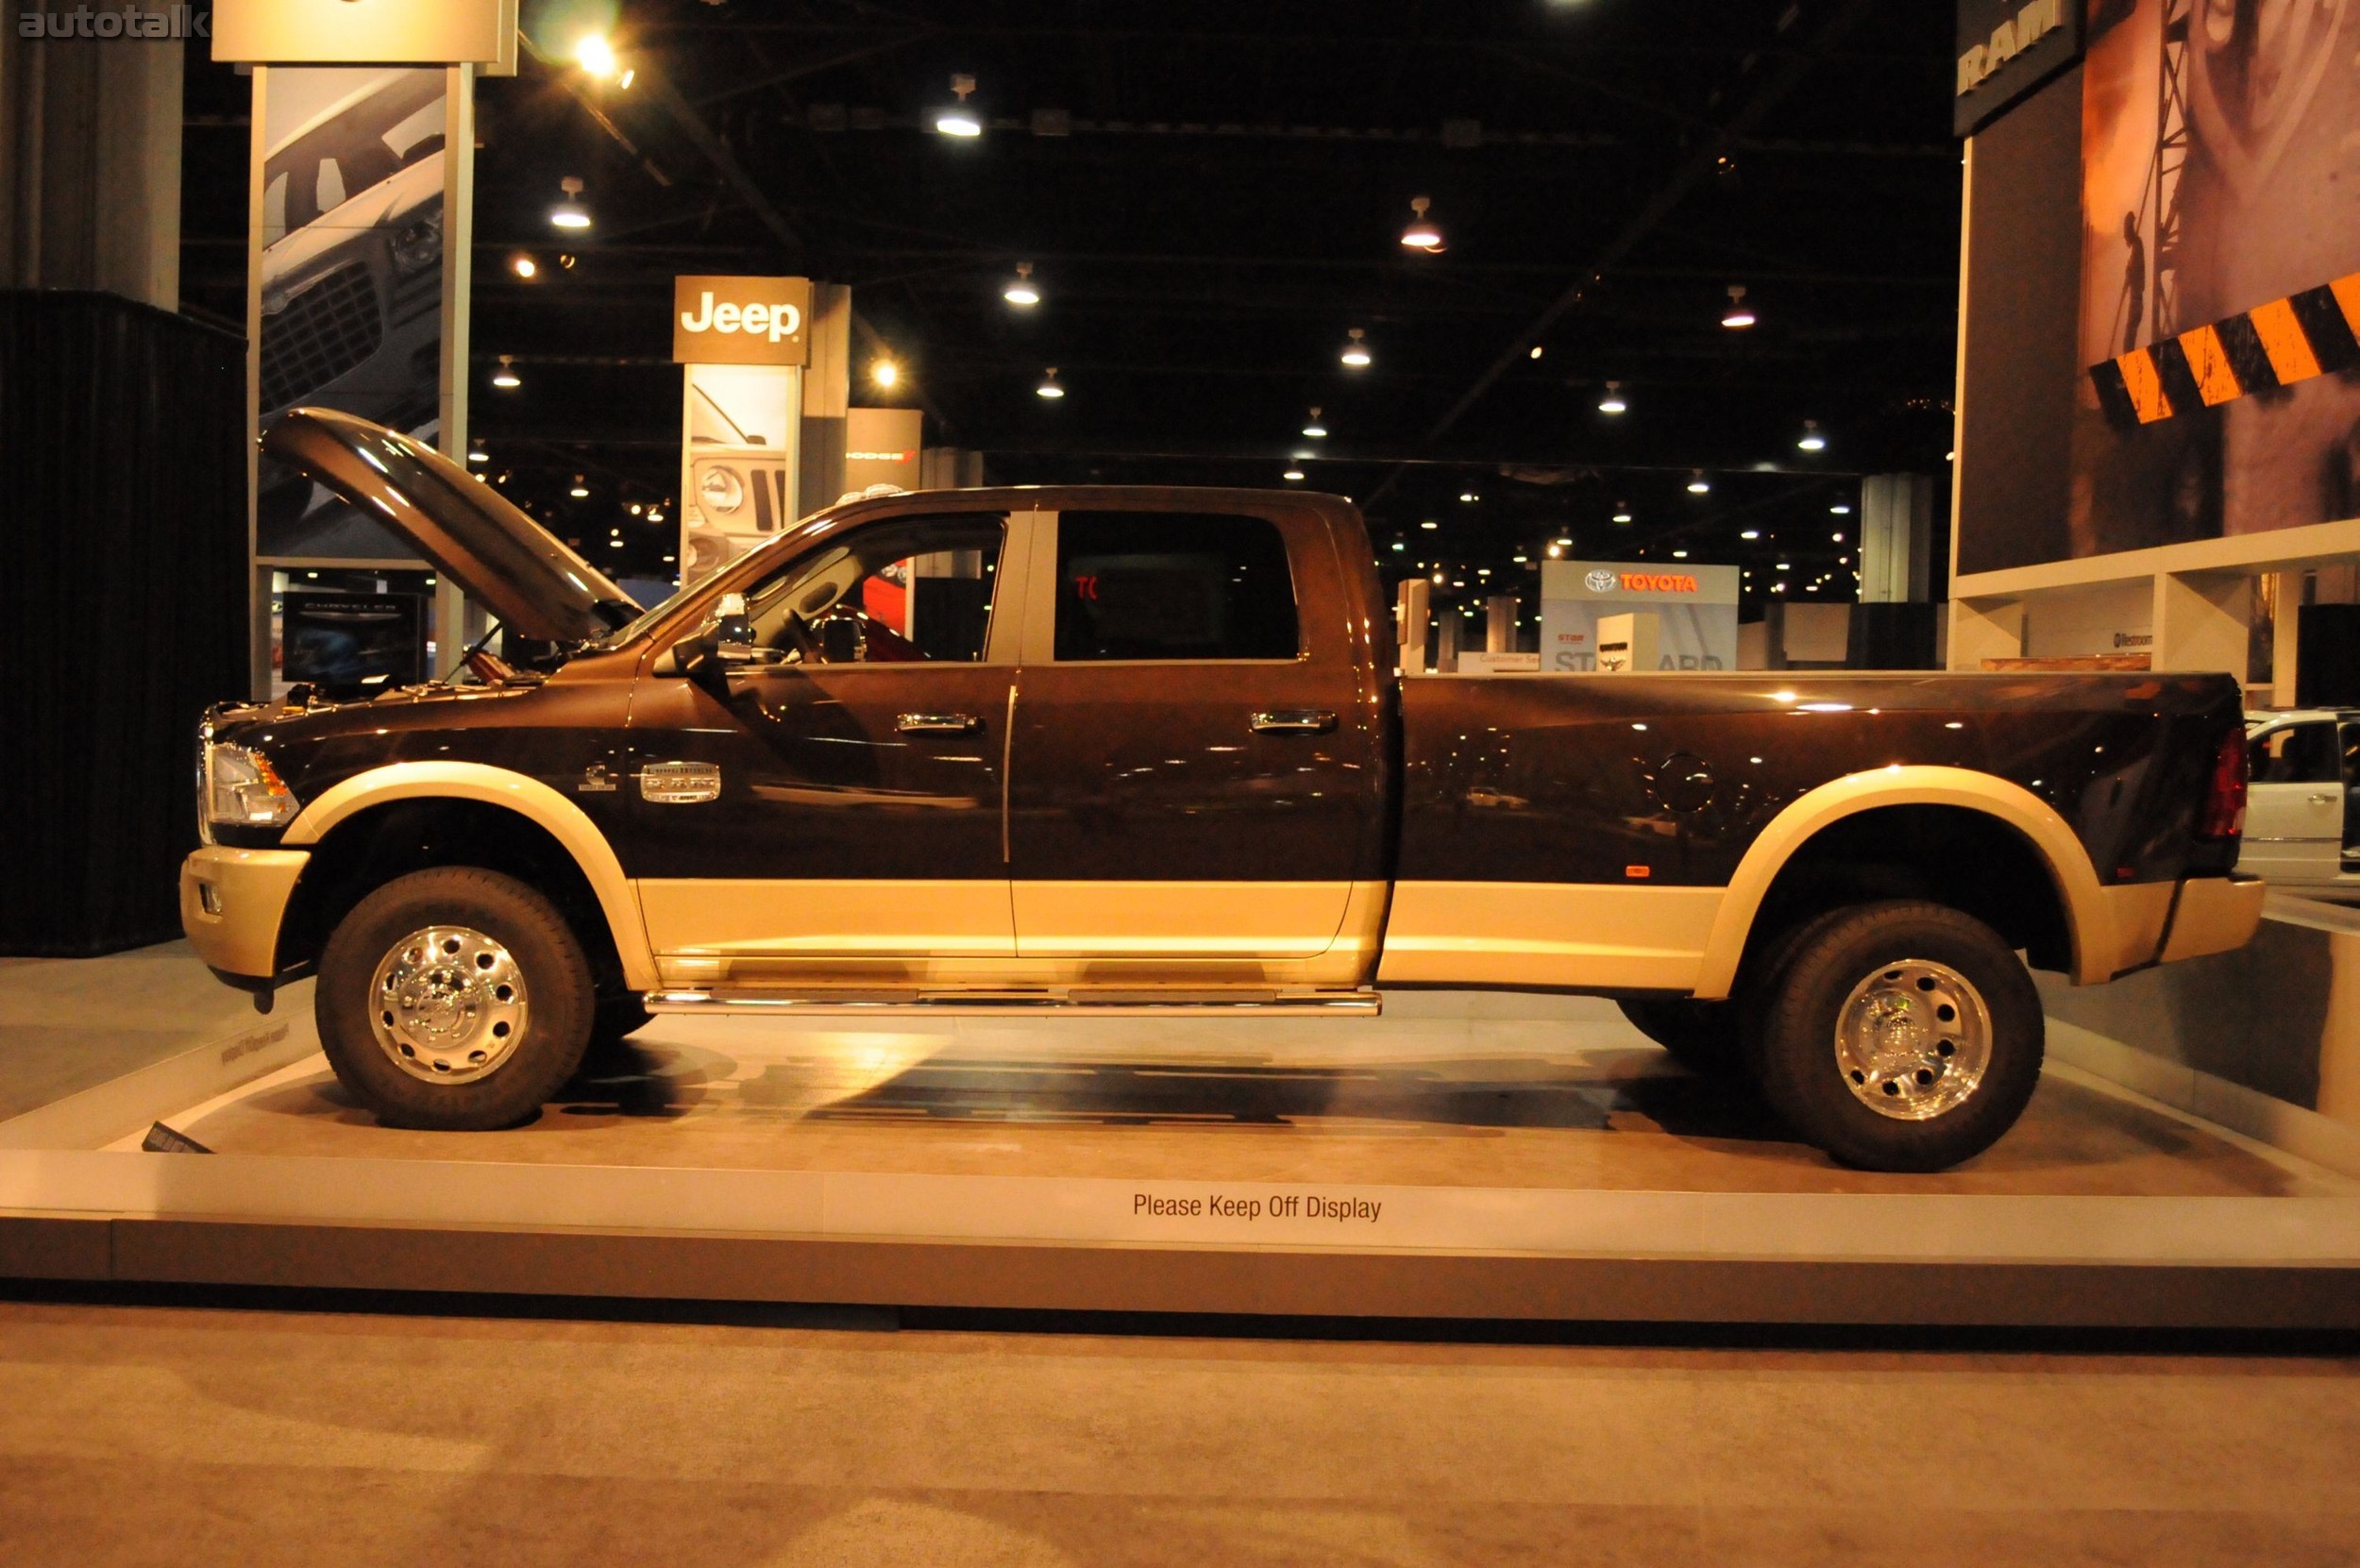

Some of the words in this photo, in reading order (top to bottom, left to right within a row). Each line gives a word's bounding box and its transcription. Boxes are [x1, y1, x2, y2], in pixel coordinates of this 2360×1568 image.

[1957, 0, 2062, 97] RAM
[681, 291, 801, 343] Jeep
[1619, 572, 1698, 593] TOYOTA
[1134, 1194, 1202, 1216] Please
[1209, 1195, 1261, 1222] Keep
[1269, 1195, 1299, 1218] Off
[1306, 1196, 1382, 1223] Display
